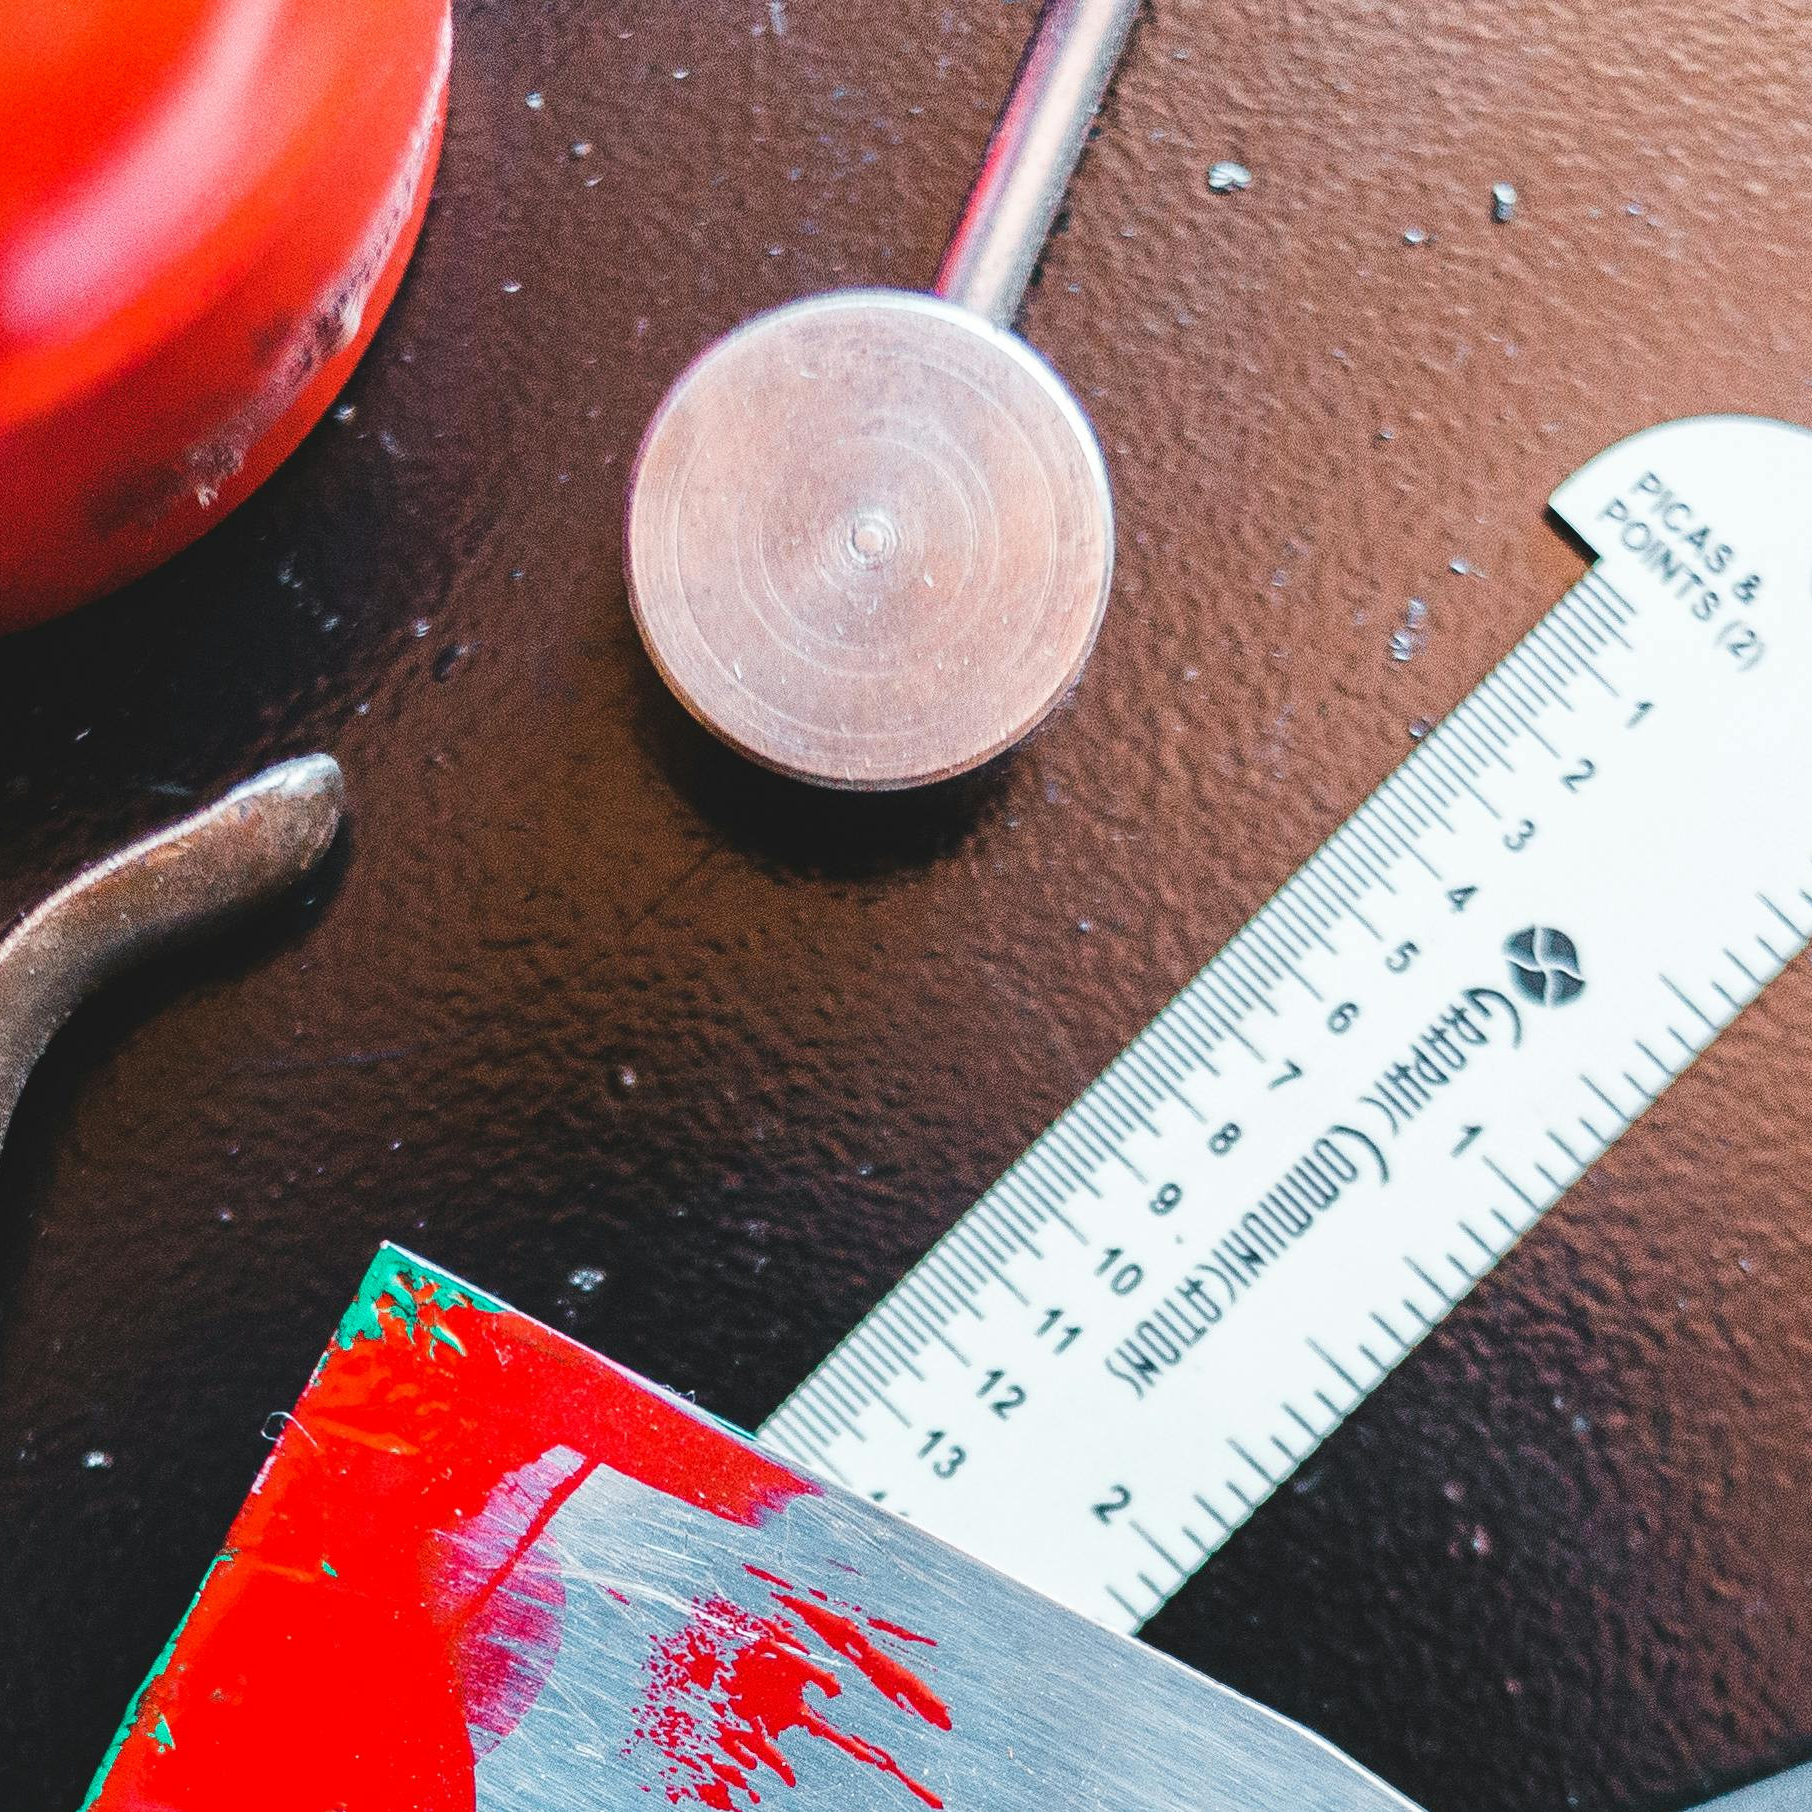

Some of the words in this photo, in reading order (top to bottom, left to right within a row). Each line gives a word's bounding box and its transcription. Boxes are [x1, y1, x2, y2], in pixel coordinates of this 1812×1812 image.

[1631, 471, 1732, 571] PICAS
[1734, 574, 1762, 603] &
[1598, 498, 1721, 621] POINTS
[1715, 620, 1766, 672] (2)
[1624, 700, 1653, 729] 1
[1560, 759, 1596, 793] 2
[1504, 819, 1537, 853] 3
[1446, 883, 1478, 912] 4
[1386, 940, 1421, 974] 5
[1328, 1001, 1361, 1035] 6
[1268, 1061, 1303, 1091] 7
[1208, 1122, 1242, 1157] 8
[1452, 1123, 1483, 1157] 1
[1149, 1183, 1183, 1217] 9
[1092, 1246, 1144, 1296] 10
[1035, 1307, 1083, 1355] 11
[976, 1368, 1026, 1420] 12
[916, 1429, 967, 1479] 13
[1091, 1484, 1132, 1525] 2
